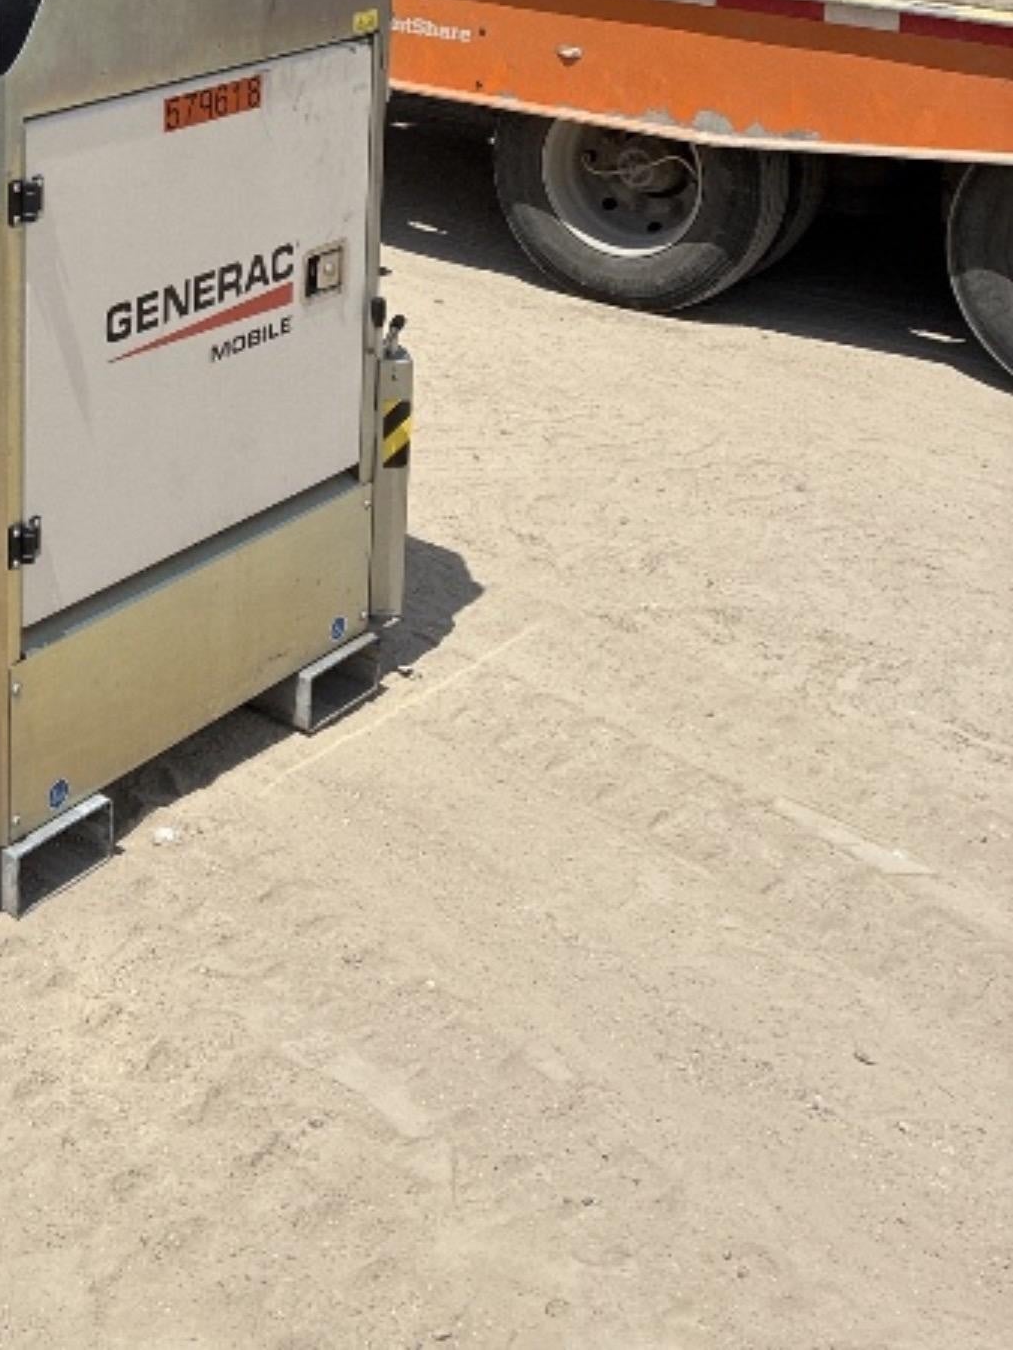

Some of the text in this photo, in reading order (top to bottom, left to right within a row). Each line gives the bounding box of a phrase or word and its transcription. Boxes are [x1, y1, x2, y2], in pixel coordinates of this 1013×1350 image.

[165, 76, 262, 131] 579618
[106, 243, 294, 343] GENERAC
[210, 317, 291, 362] MOBILE
